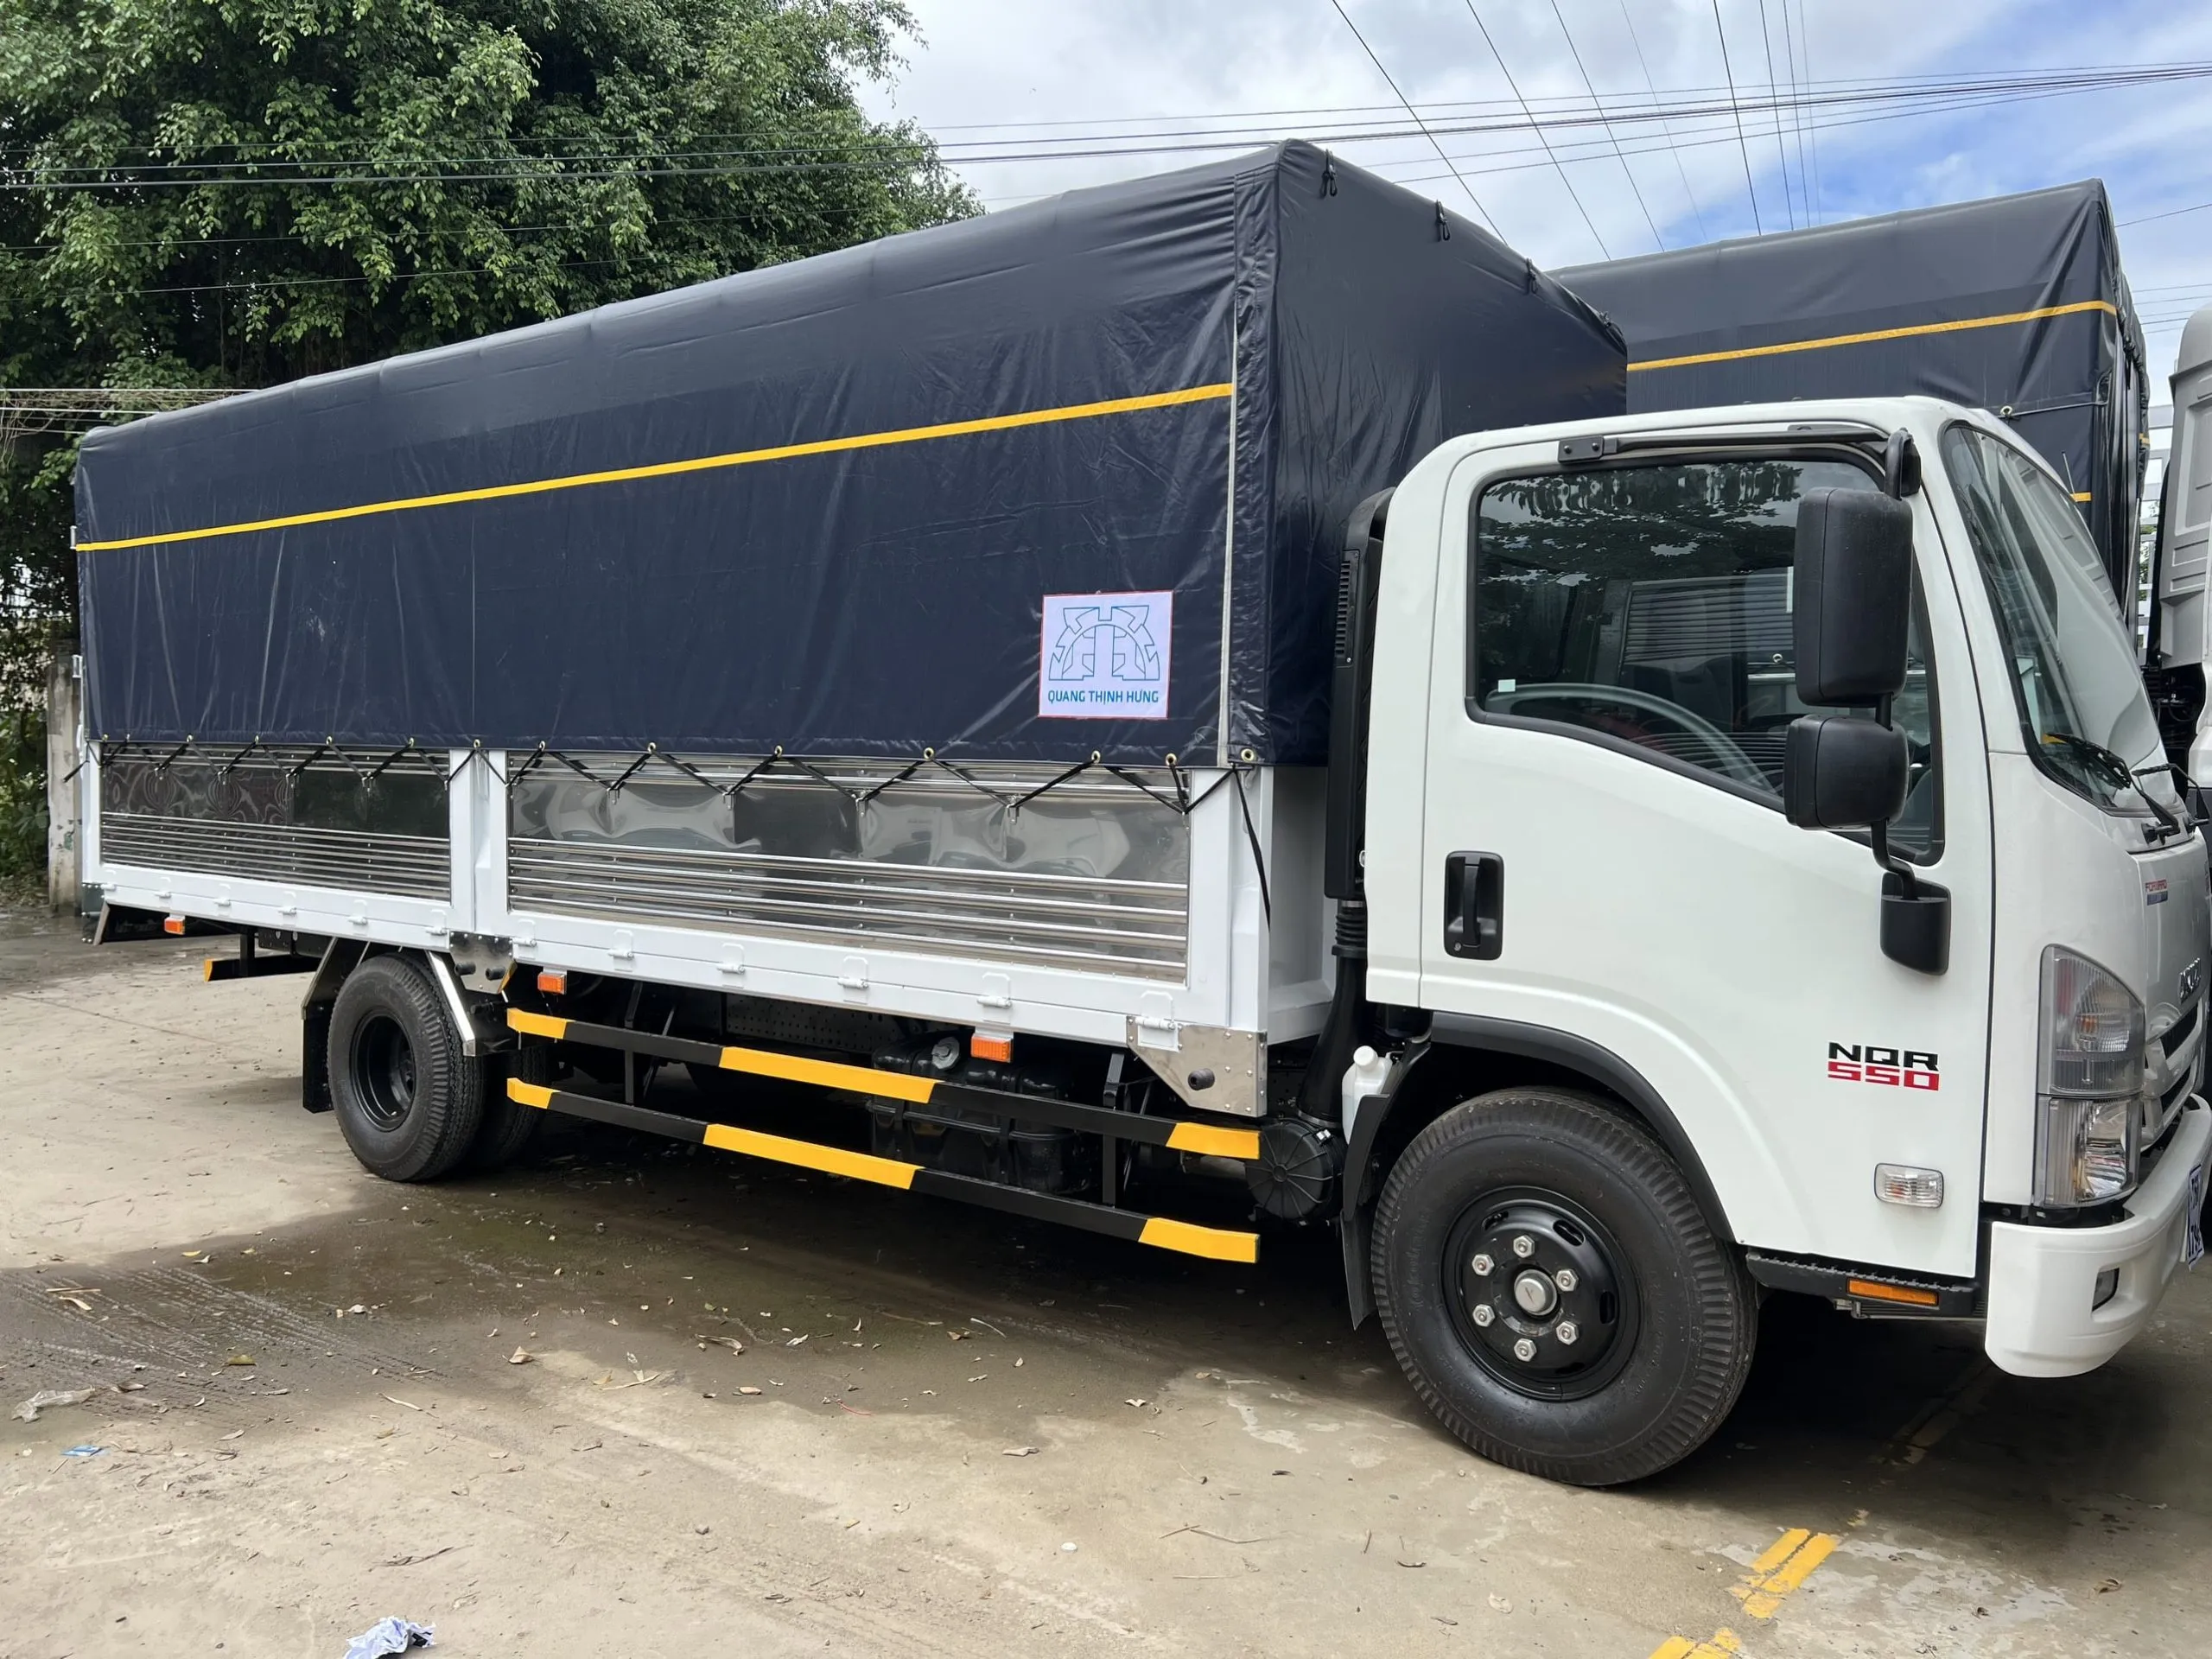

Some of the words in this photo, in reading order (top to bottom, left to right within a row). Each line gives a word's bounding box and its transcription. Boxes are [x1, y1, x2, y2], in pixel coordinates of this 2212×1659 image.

[1048, 690, 1085, 703] QUANG
[1090, 690, 1122, 704] THỊNH
[1828, 1041, 1939, 1071] NQR
[1828, 1061, 1940, 1090] 550
